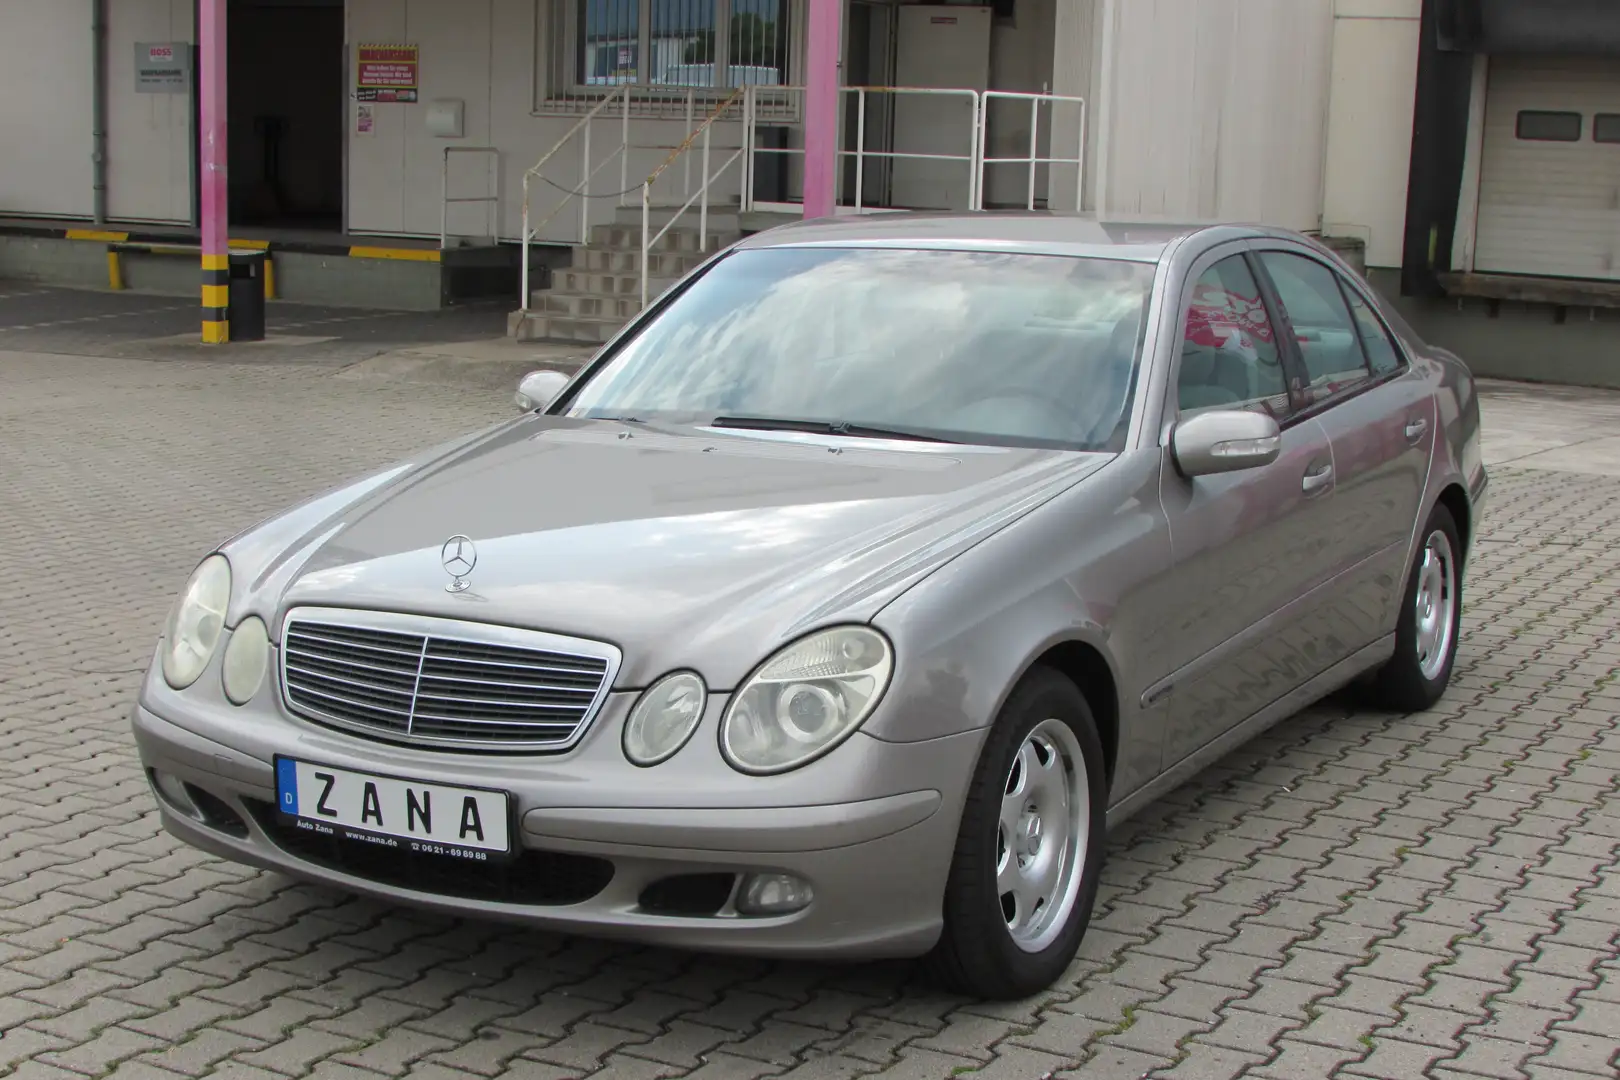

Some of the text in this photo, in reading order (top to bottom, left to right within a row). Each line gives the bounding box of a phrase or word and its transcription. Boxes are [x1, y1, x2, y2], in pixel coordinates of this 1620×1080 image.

[285, 792, 293, 804] D
[296, 820, 314, 830] Auto
[315, 823, 334, 834] Zana
[345, 831, 398, 847] www.zana.de
